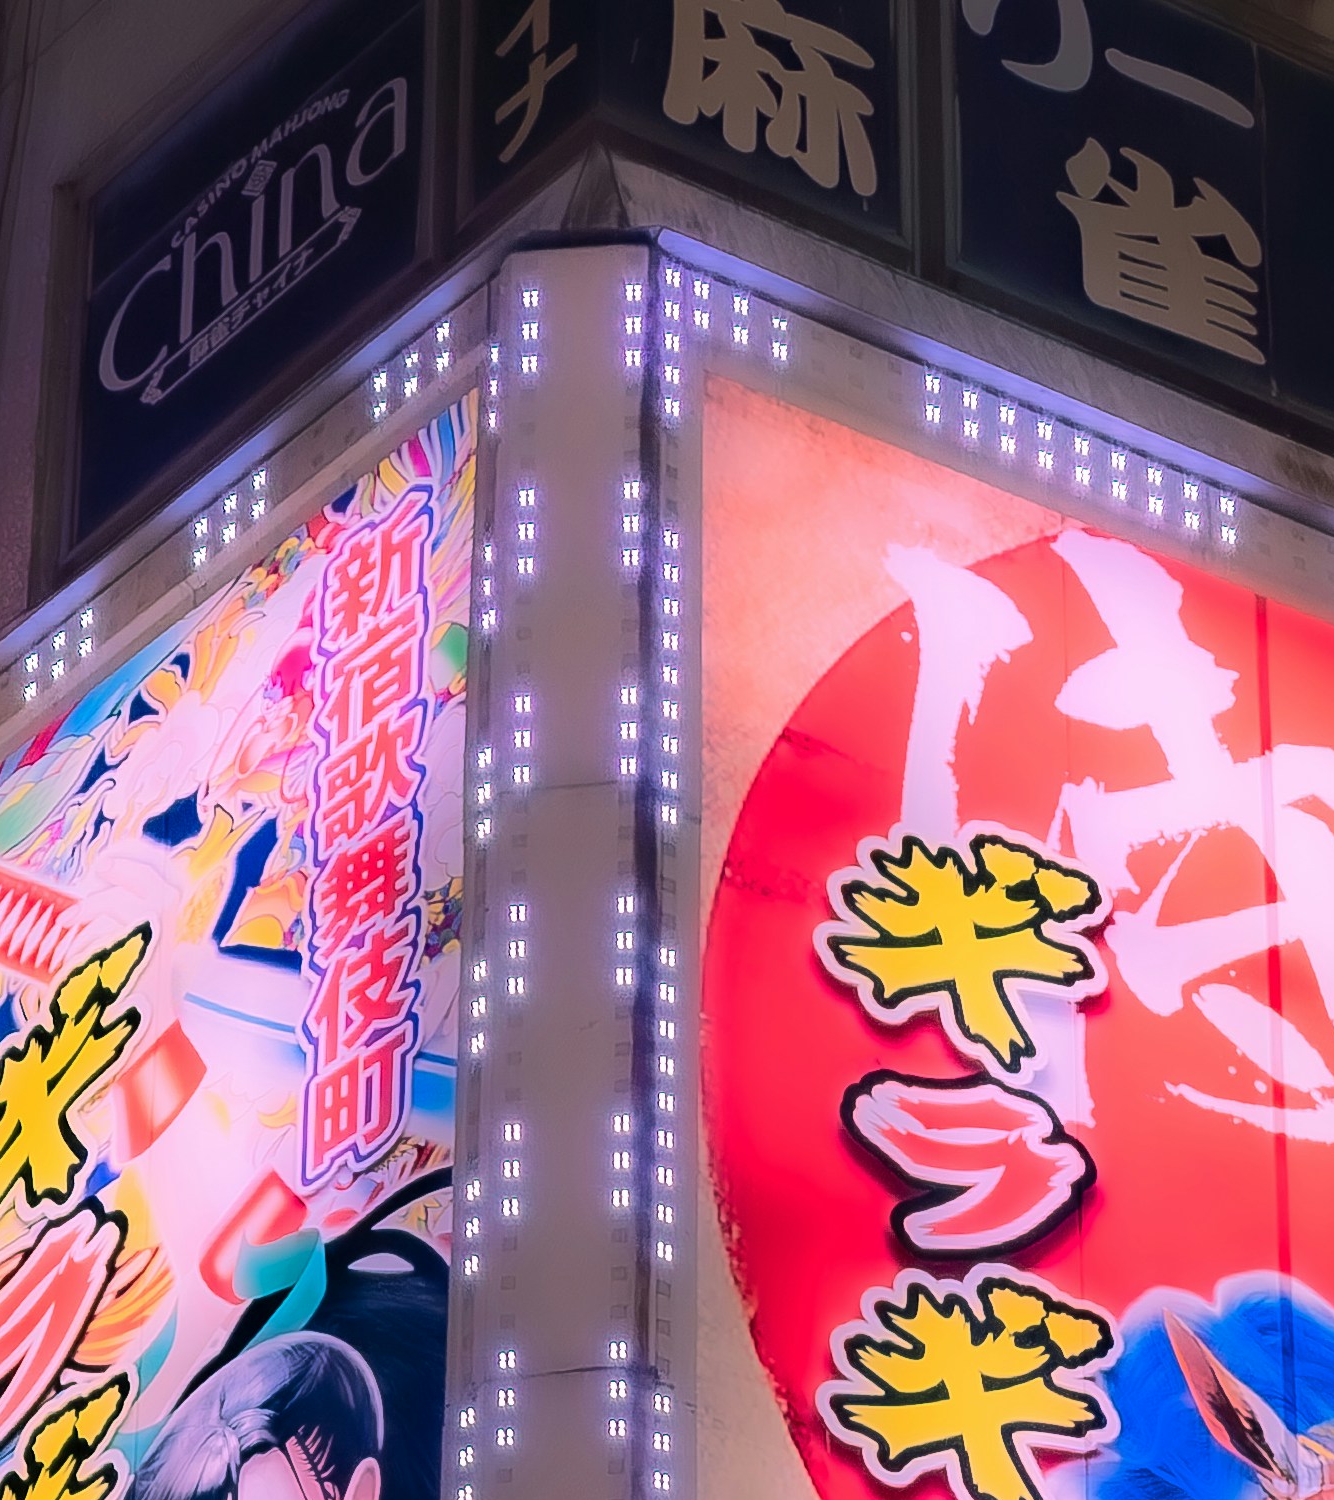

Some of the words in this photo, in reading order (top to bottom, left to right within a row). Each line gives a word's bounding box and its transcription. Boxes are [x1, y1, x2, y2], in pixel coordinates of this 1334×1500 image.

[99, 77, 407, 392] China
[253, 88, 351, 161] MAHJONG
[305, 486, 437, 1187] 新宿歌舞伎町
